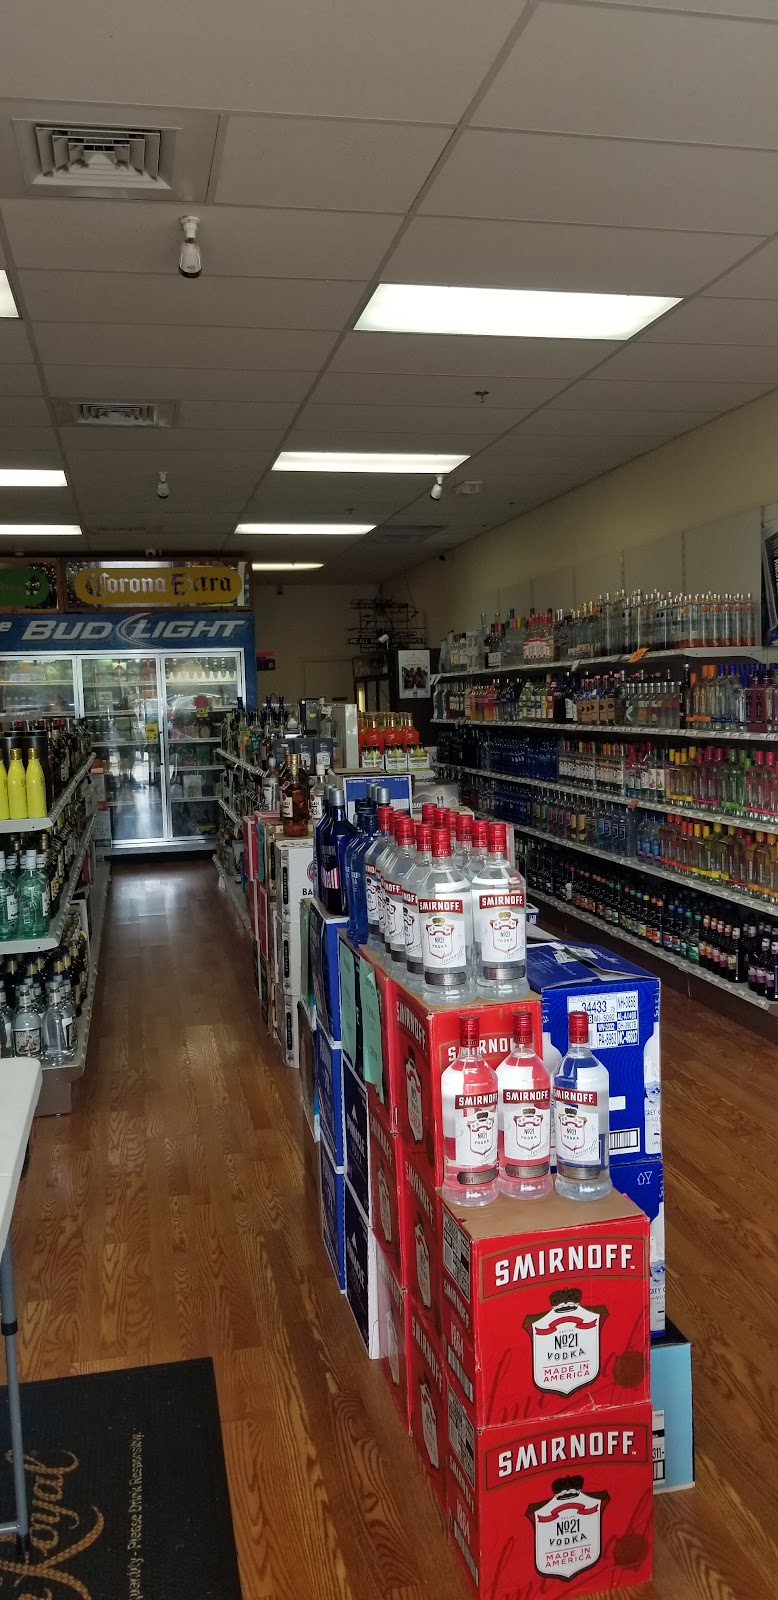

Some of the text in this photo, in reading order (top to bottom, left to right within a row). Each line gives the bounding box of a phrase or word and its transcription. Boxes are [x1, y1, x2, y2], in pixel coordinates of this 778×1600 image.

[85, 572, 232, 598] Corona Extra
[21, 619, 246, 641] BUD LIGHT
[419, 901, 460, 911] SMIRNOFF
[481, 895, 523, 906] SMIRNOFF
[581, 1000, 607, 1013] 34433
[396, 1001, 426, 1050] SMIRNOFF
[506, 1090, 549, 1102] SMIRNOFF
[552, 1088, 594, 1103] SMIRNOFF
[494, 1245, 633, 1287] SMIRNOFF
[411, 1316, 443, 1393] SMIRNOFF
[547, 1348, 586, 1361] VODKA
[543, 1370, 591, 1383] AMERICA
[544, 1363, 589, 1376] MADE IN
[498, 1431, 635, 1477] SMIRNOFF
[129, 1485, 143, 1512] Drink
[127, 1514, 143, 1549] Please
[549, 1533, 587, 1547] VODKA
[545, 1547, 591, 1562] MADE IN
[545, 1554, 592, 1568] AMERICA
